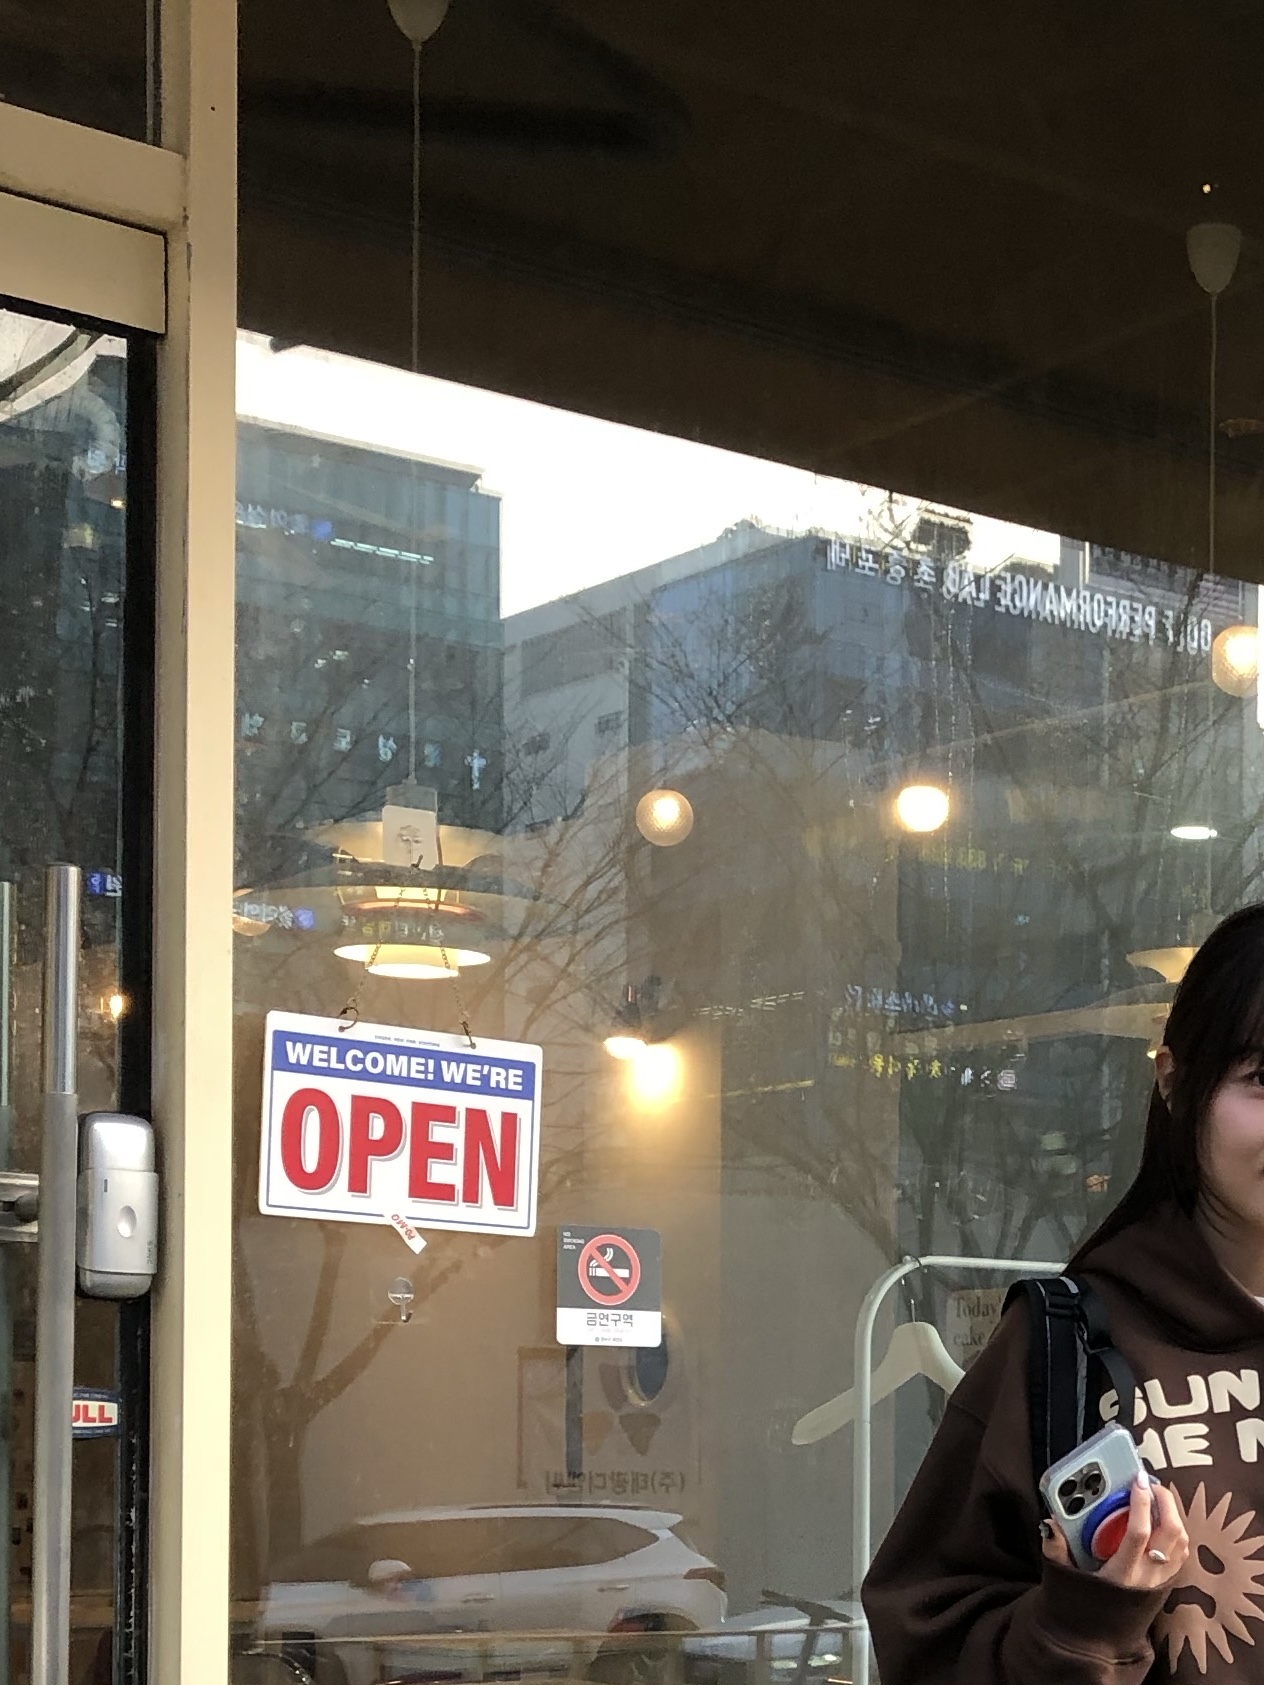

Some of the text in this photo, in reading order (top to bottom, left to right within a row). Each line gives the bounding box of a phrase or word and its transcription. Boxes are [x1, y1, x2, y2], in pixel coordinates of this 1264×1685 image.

[285, 1040, 523, 1091] WELCOME! WE'RE
[281, 1087, 519, 1209] OPEN
[586, 1312, 633, 1327] 금연구역
[956, 1295, 1002, 1322] Today'
[73, 1404, 112, 1424] ULL
[1100, 1369, 1260, 1425] SUN
[1139, 1423, 1213, 1470] HE
